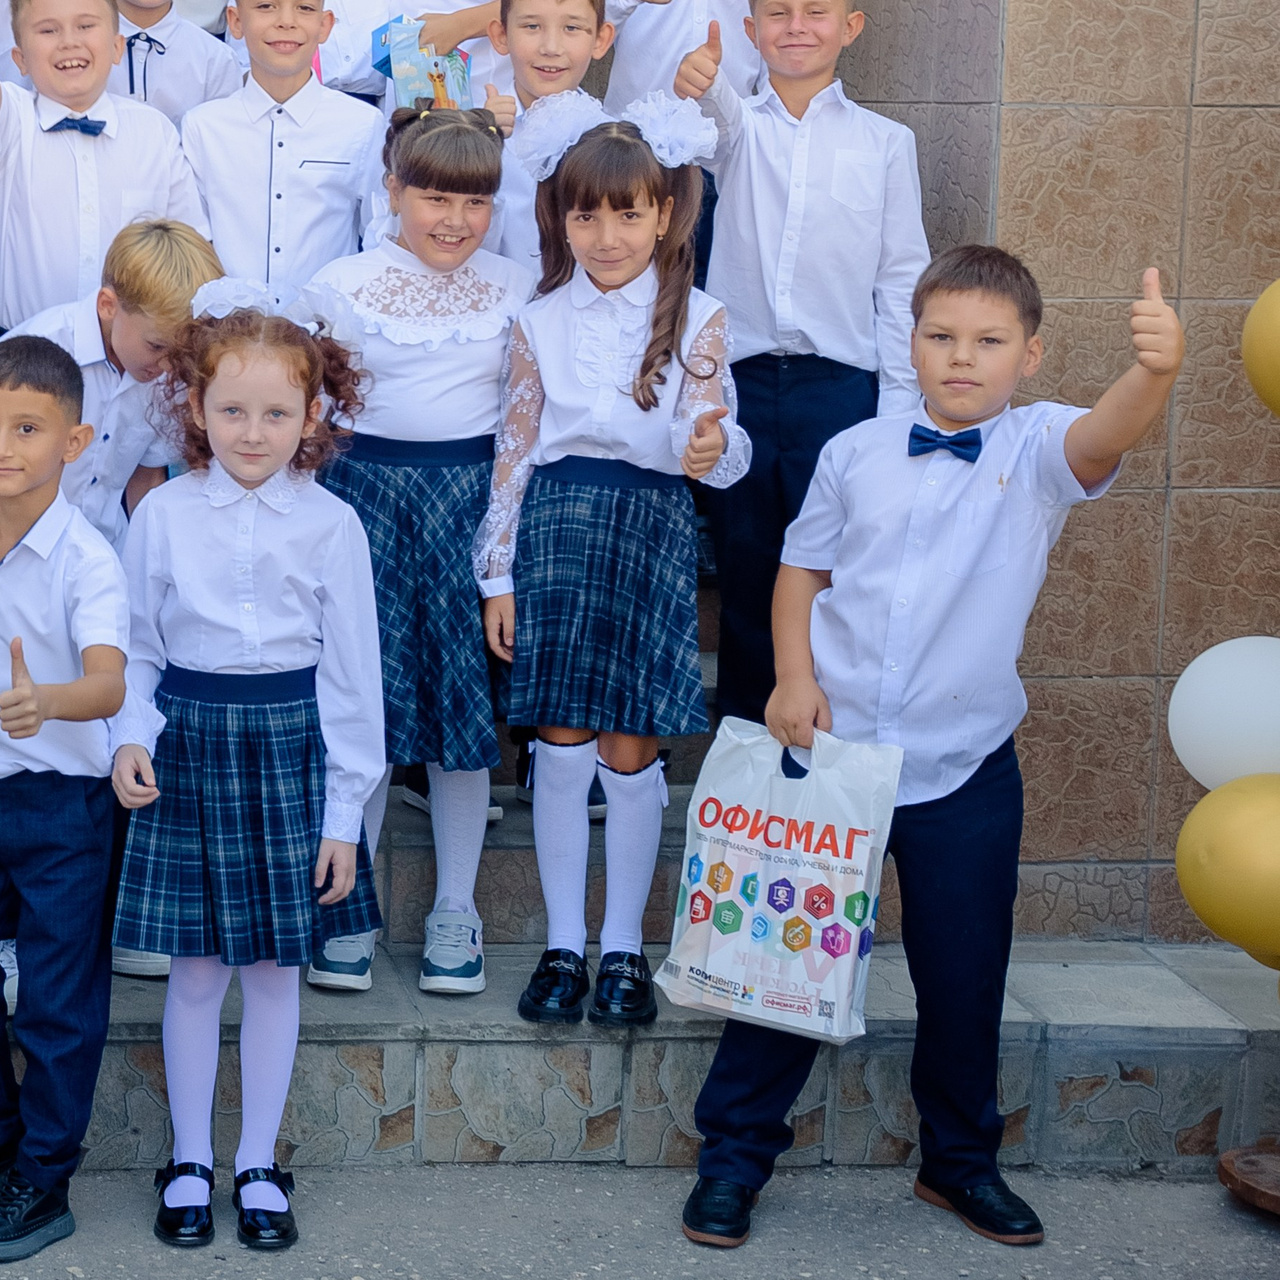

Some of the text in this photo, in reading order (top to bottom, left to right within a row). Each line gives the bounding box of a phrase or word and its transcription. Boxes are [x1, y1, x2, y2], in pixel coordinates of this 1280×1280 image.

[699, 796, 869, 860] ОФИСМАГ
[802, 860, 831, 872] УЧЕБЫ
[838, 866, 864, 877] ДОМА
[688, 965, 741, 991] копицентр
